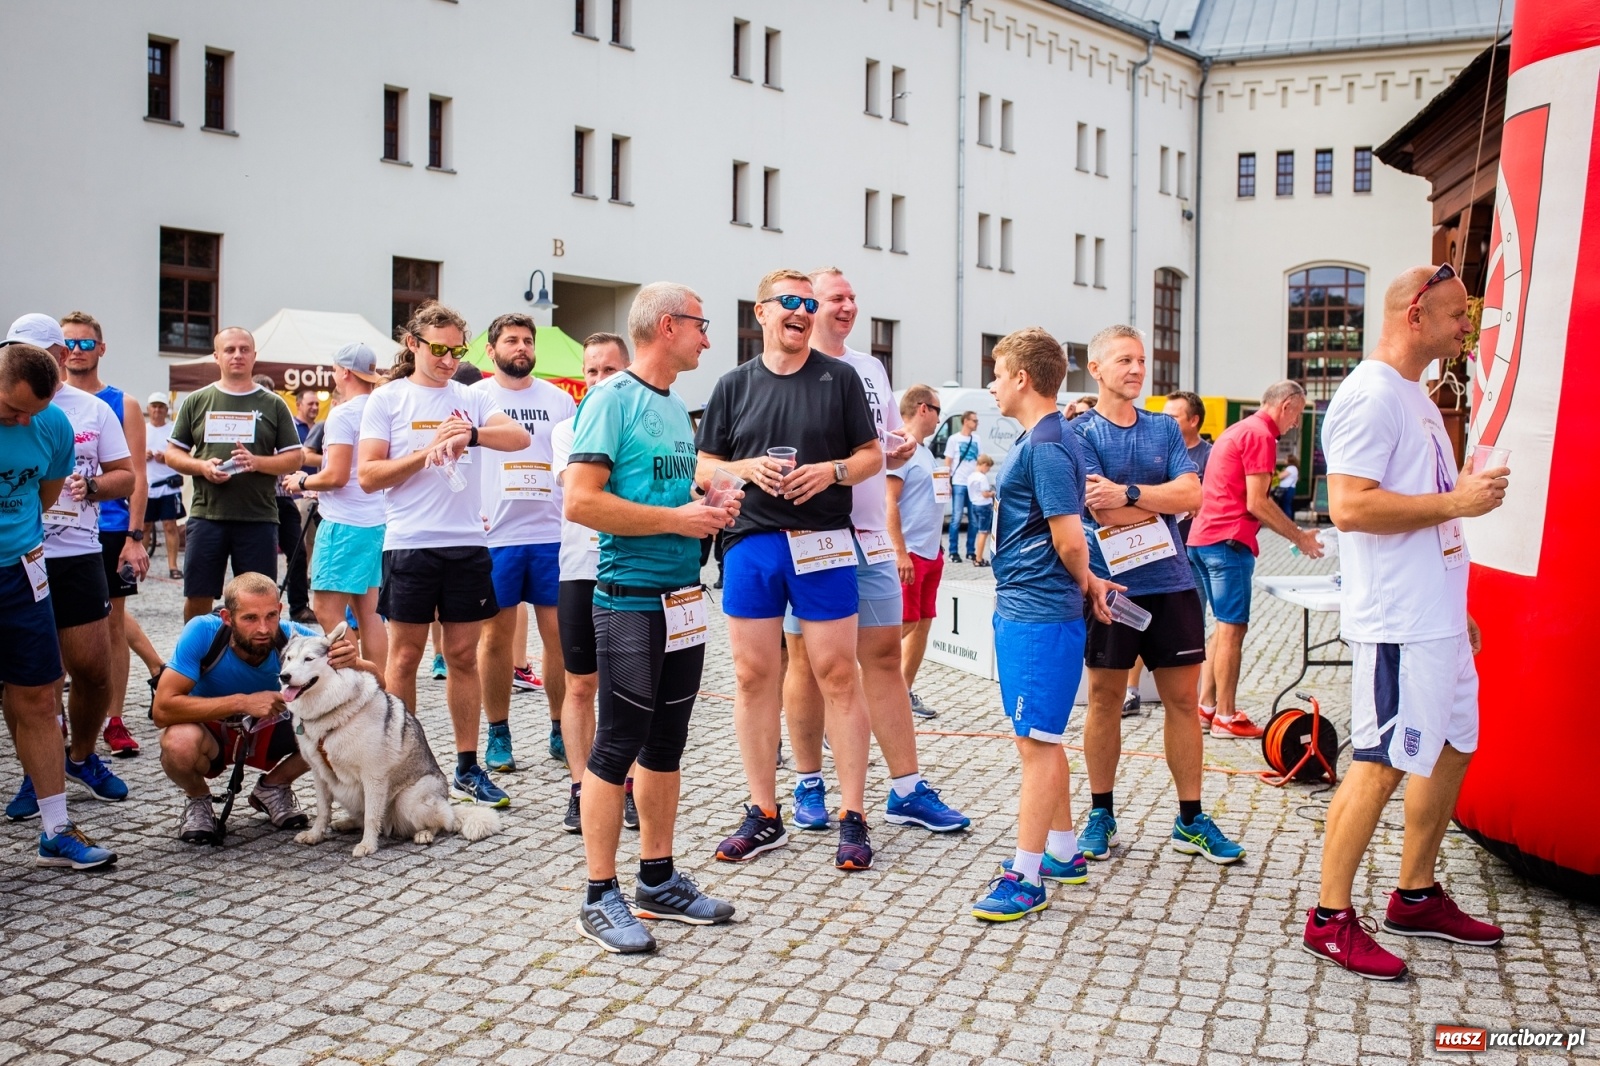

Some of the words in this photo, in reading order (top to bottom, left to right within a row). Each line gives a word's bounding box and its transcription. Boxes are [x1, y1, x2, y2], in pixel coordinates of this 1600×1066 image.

[552, 238, 565, 257] B
[520, 409, 550, 422] HUTA
[224, 423, 237, 432] 57
[523, 474, 537, 485] 55
[817, 537, 834, 551] 18
[875, 535, 886, 546] 21
[1126, 534, 1145, 549] 22
[683, 610, 695, 626] 14
